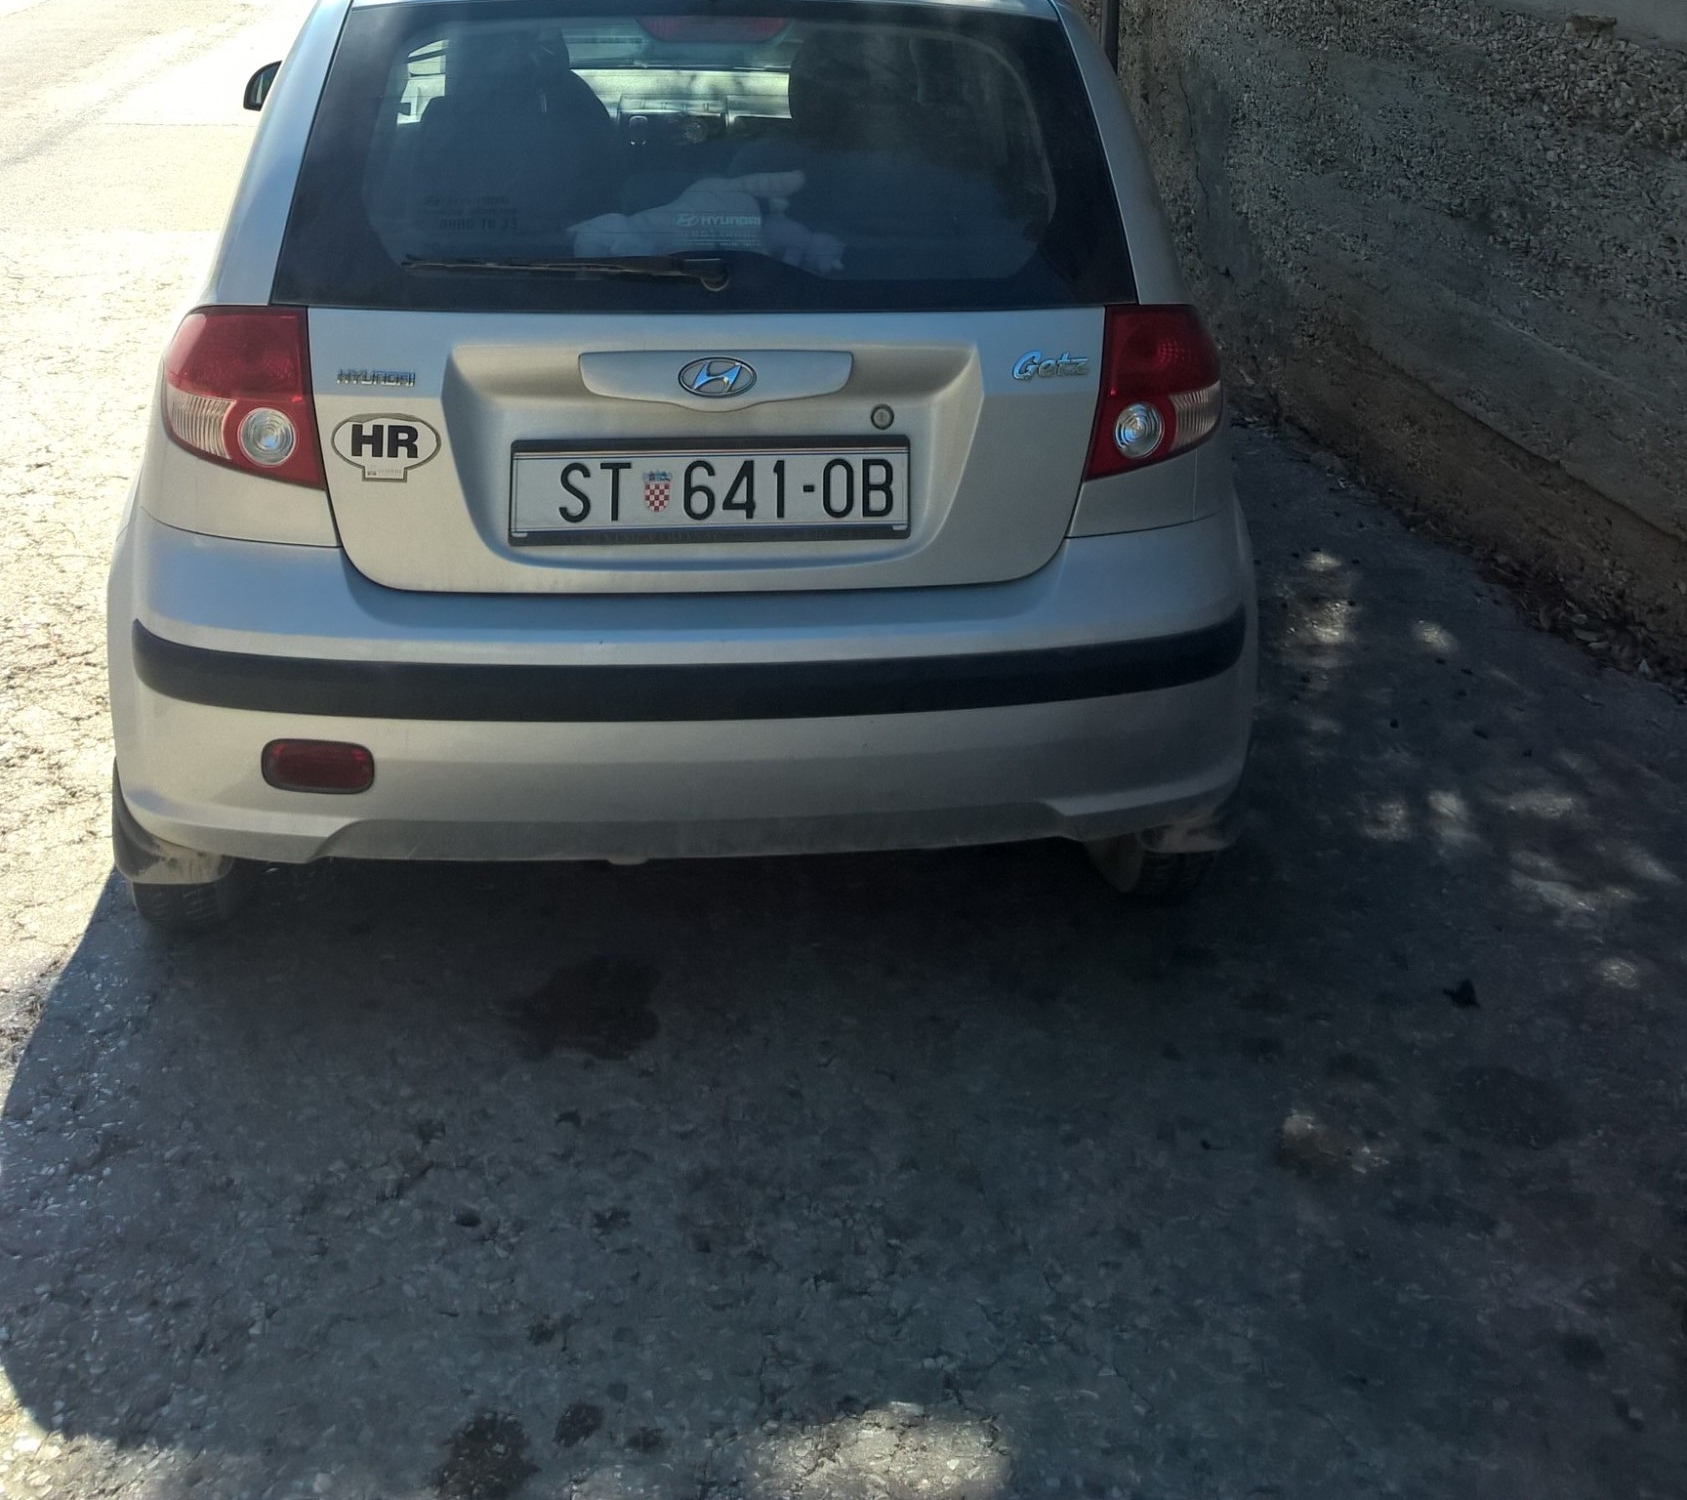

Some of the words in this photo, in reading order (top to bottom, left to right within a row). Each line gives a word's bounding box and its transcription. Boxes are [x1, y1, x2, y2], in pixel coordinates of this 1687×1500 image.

[336, 369, 416, 387] HYUNDAI
[1012, 349, 1089, 380] Getz
[351, 424, 419, 459] HR
[558, 461, 632, 523] ST
[683, 458, 894, 521] 641-OB
